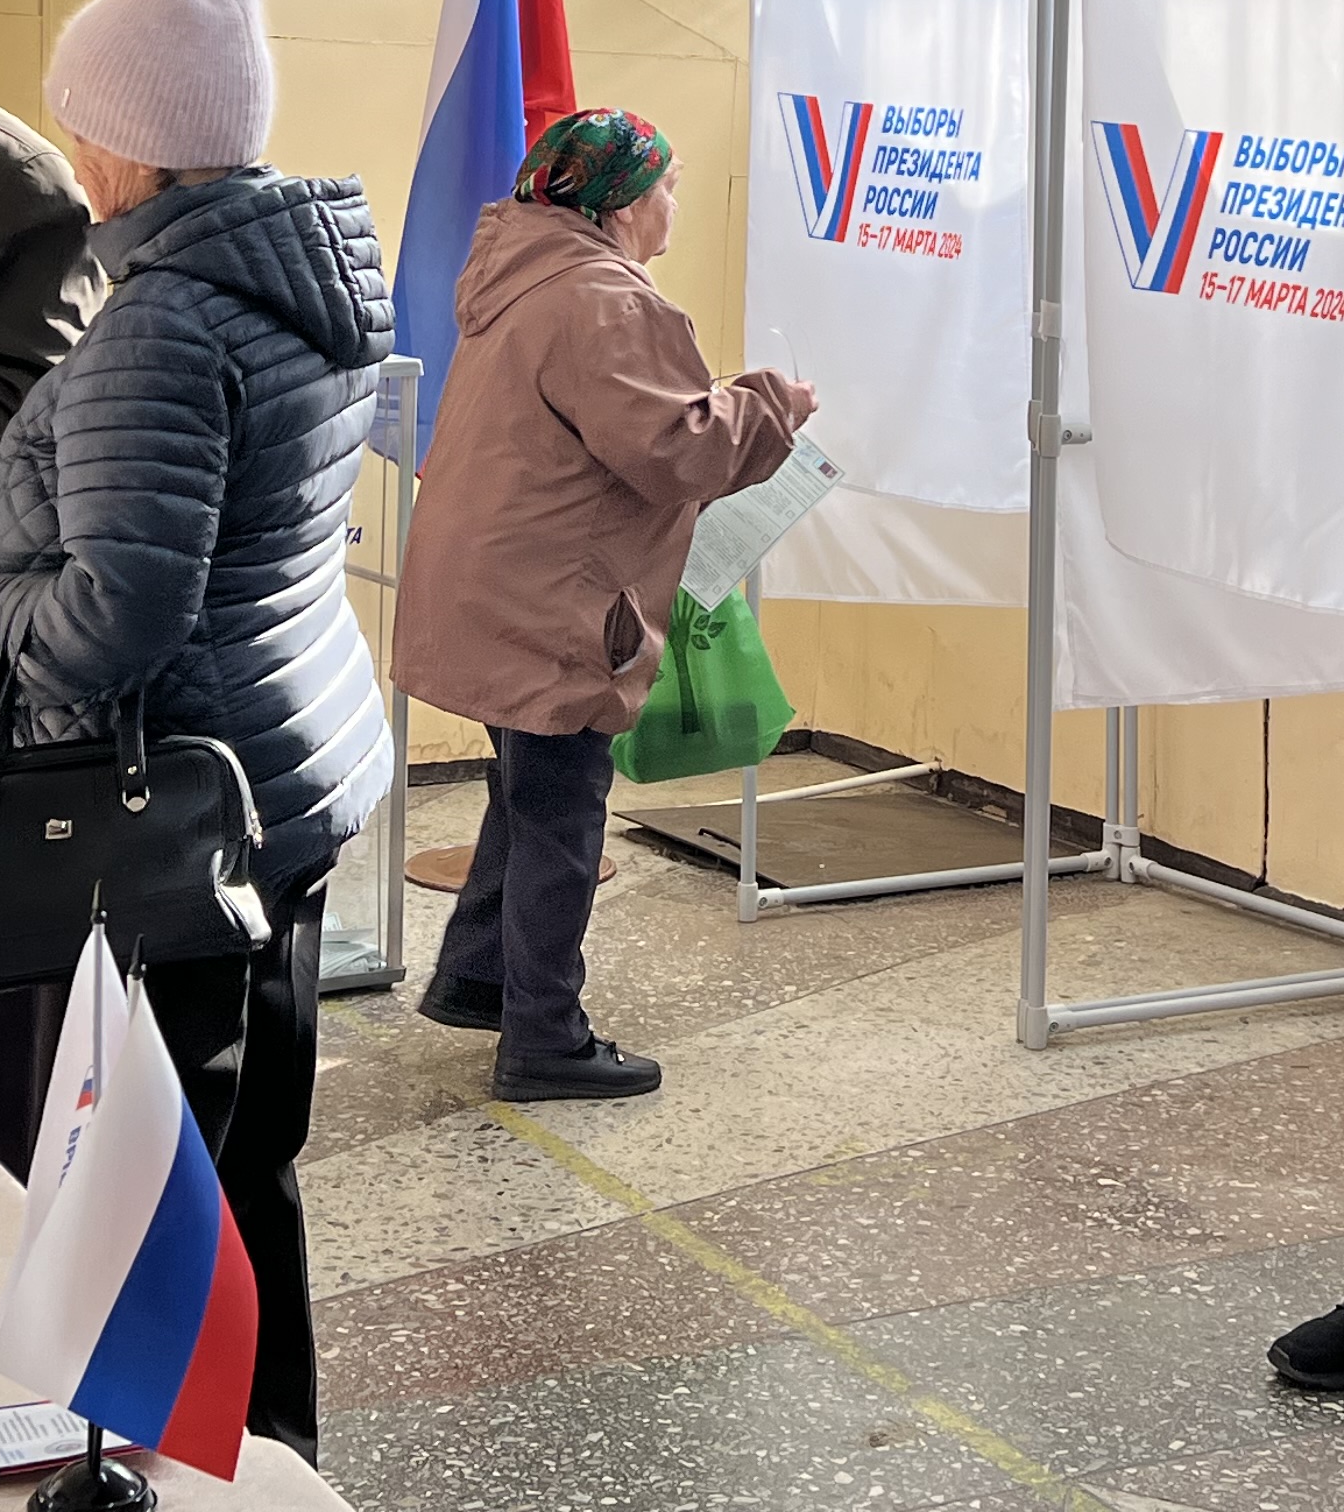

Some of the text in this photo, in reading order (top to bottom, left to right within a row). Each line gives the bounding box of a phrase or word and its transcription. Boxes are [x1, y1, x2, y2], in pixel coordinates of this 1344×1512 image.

[881, 105, 964, 138] ВЫБОРЫ
[872, 145, 983, 184] ПРЕЗИДЕНТА
[863, 184, 938, 220] РОССИИ
[892, 228, 937, 256] МАРТА
[937, 232, 963, 260] 2024
[1208, 227, 1311, 273] РОССИИ
[1243, 277, 1306, 316] МАРТА
